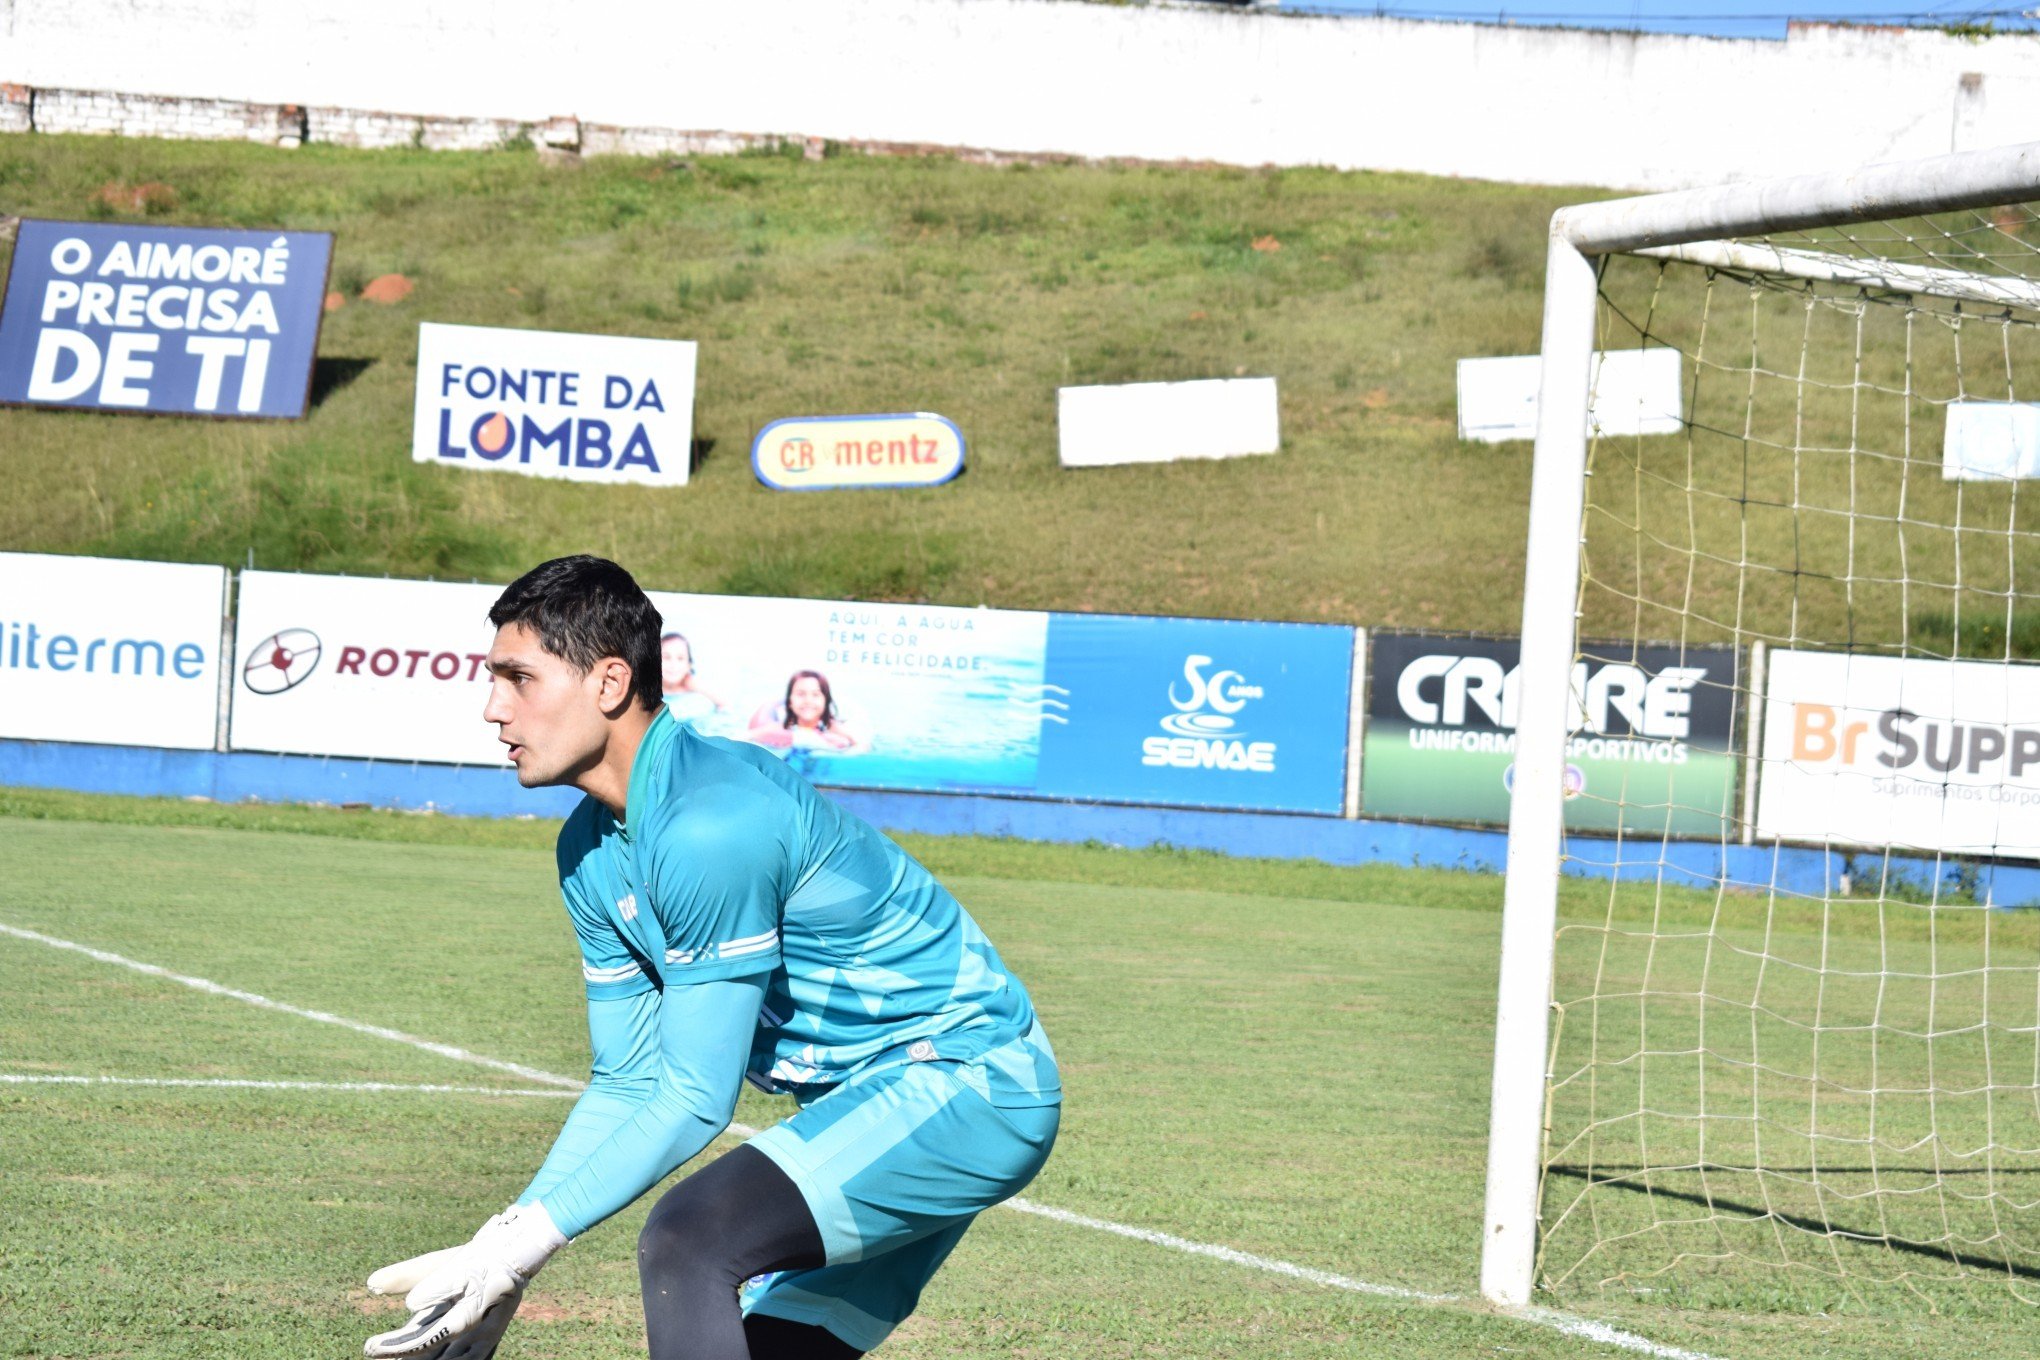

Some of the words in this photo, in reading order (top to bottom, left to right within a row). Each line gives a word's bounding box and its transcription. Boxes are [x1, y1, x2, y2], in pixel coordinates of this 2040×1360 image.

[51, 238, 92, 275] O
[98, 235, 290, 285] AIMORÉ
[41, 280, 280, 334] PRECISA
[27, 327, 160, 407] DE
[185, 335, 271, 412] TI
[441, 363, 579, 406] FONTE
[604, 375, 665, 412] DA
[438, 408, 661, 473] LOMBA
[835, 433, 938, 466] mentz
[826, 649, 850, 663] DE
[828, 630, 866, 644] TEM
[876, 632, 918, 647] COR
[336, 646, 494, 683] ROTOT
[1141, 736, 1277, 773] SEMAE
[1408, 727, 1517, 754] UNIFORM
